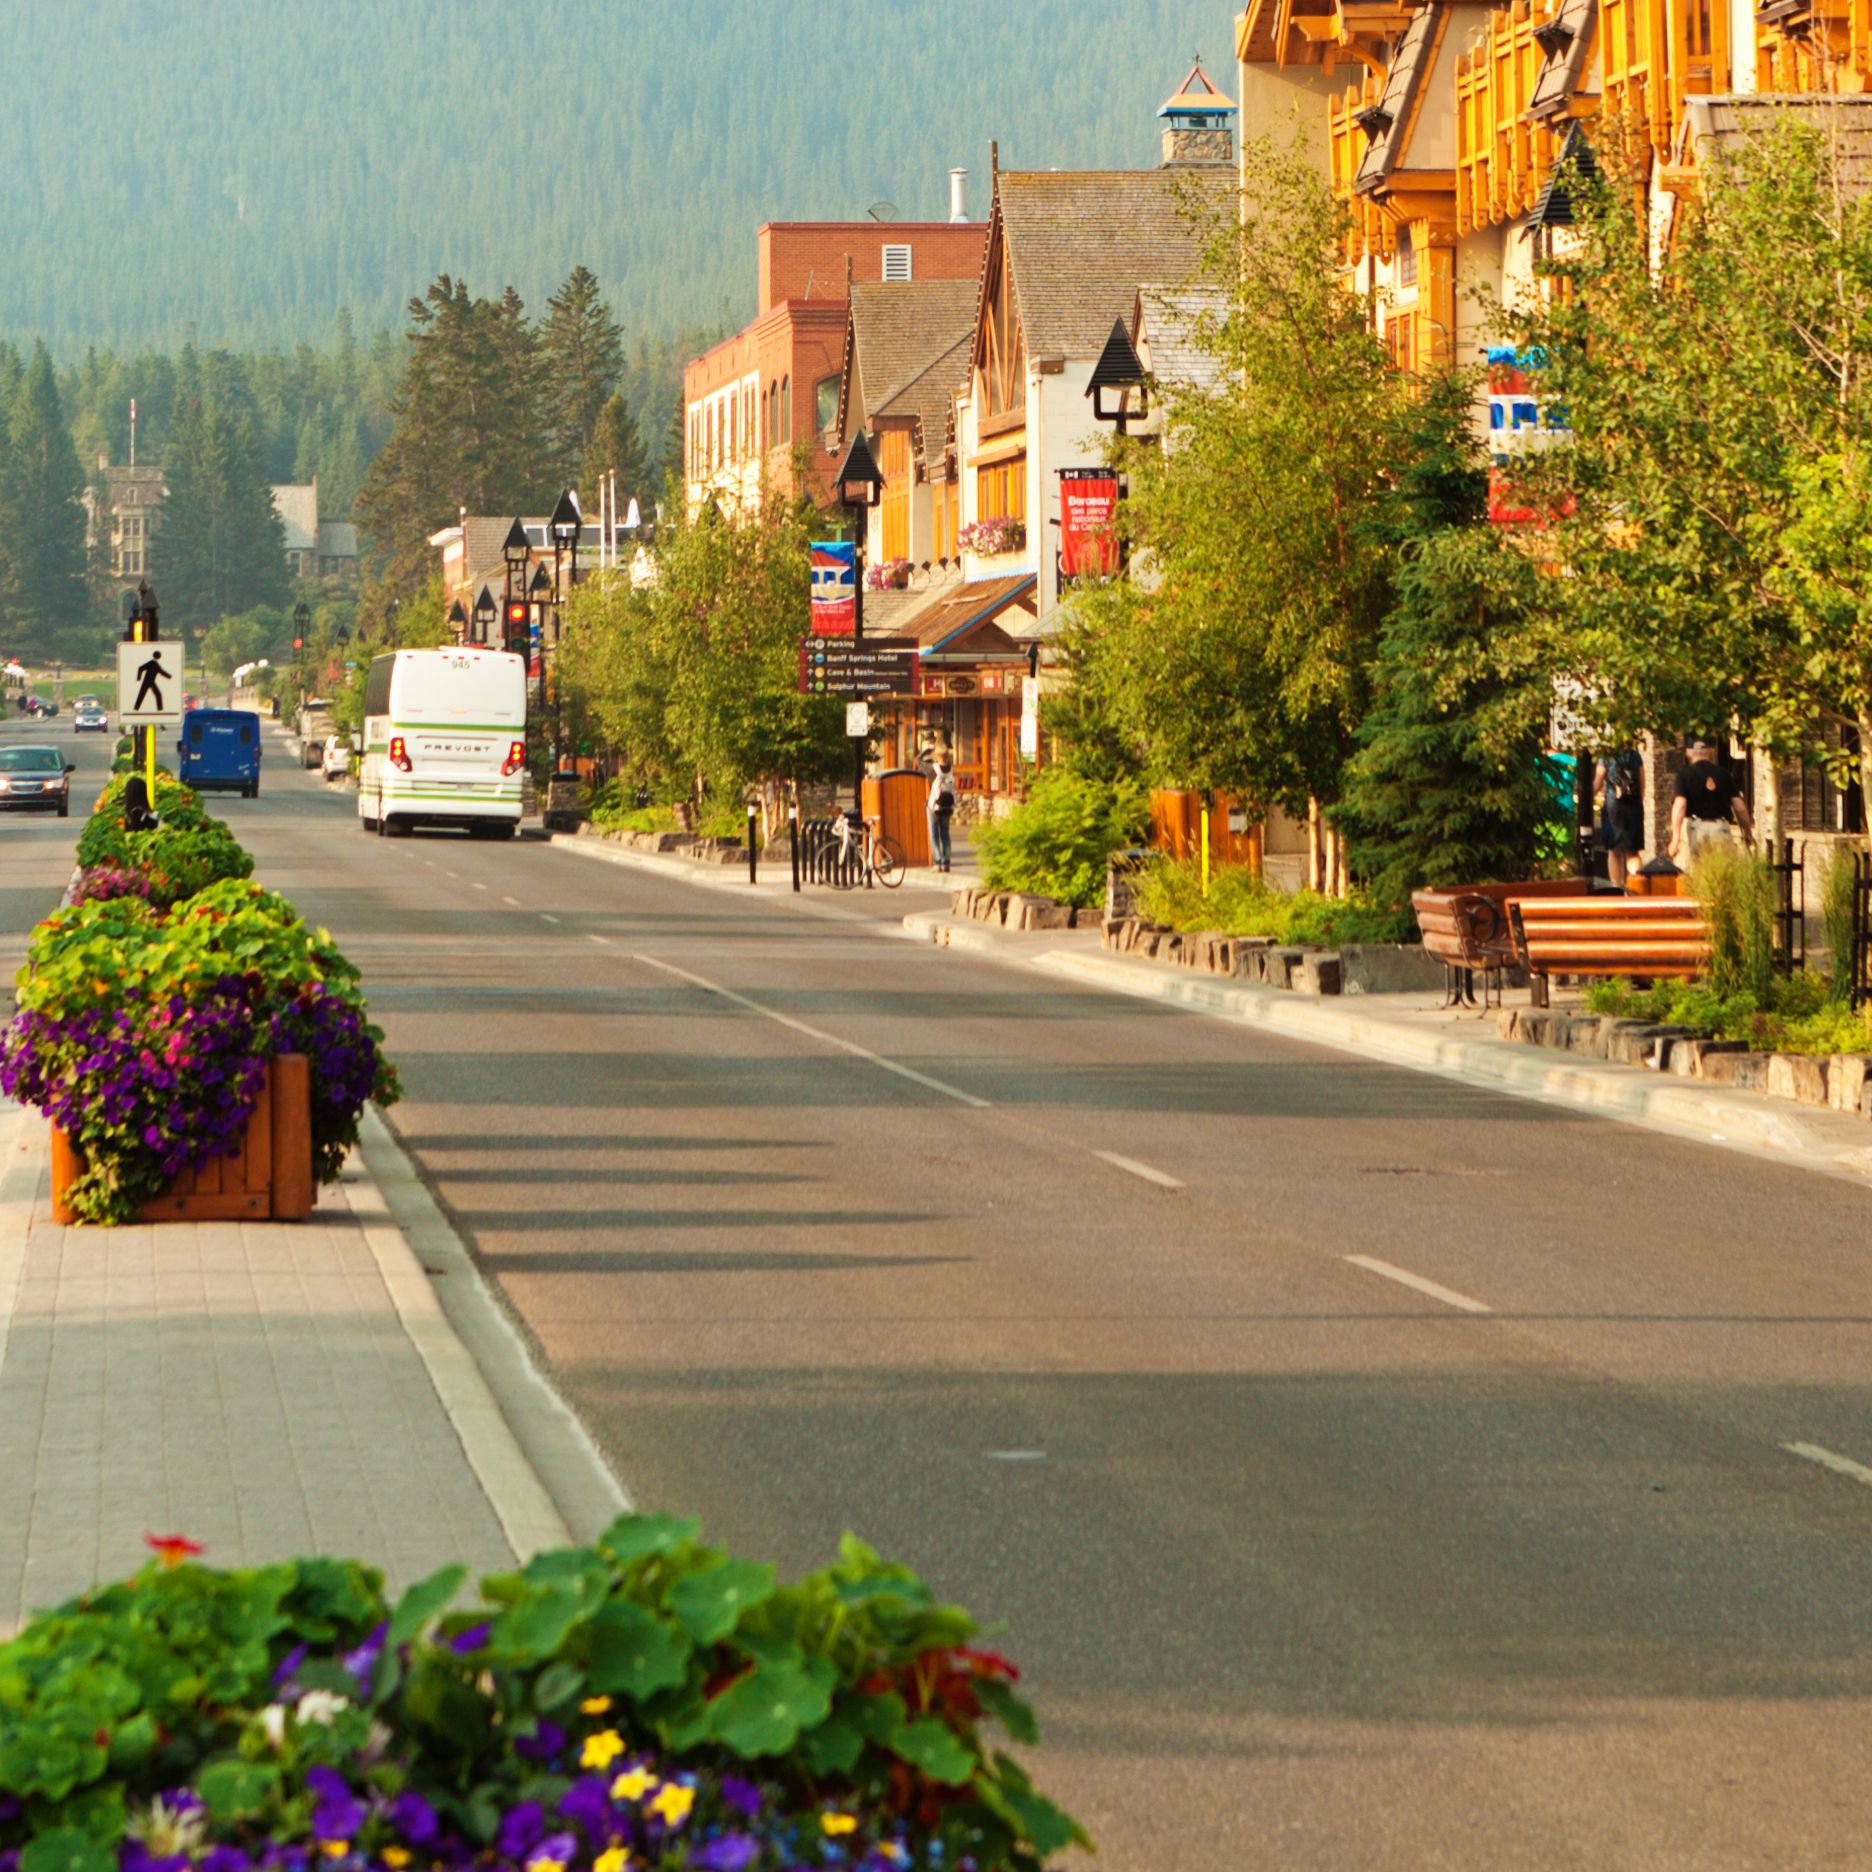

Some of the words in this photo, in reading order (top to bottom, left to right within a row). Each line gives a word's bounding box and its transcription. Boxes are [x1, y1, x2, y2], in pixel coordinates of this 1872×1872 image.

[827, 640, 855, 649] Parking
[827, 654, 847, 662] Banff
[877, 654, 898, 662] Hotel
[452, 660, 471, 669] 945
[827, 668, 845, 676] Cave
[853, 668, 875, 676] Basin
[856, 681, 891, 690] Mountain
[424, 744, 491, 752] PREVOST
